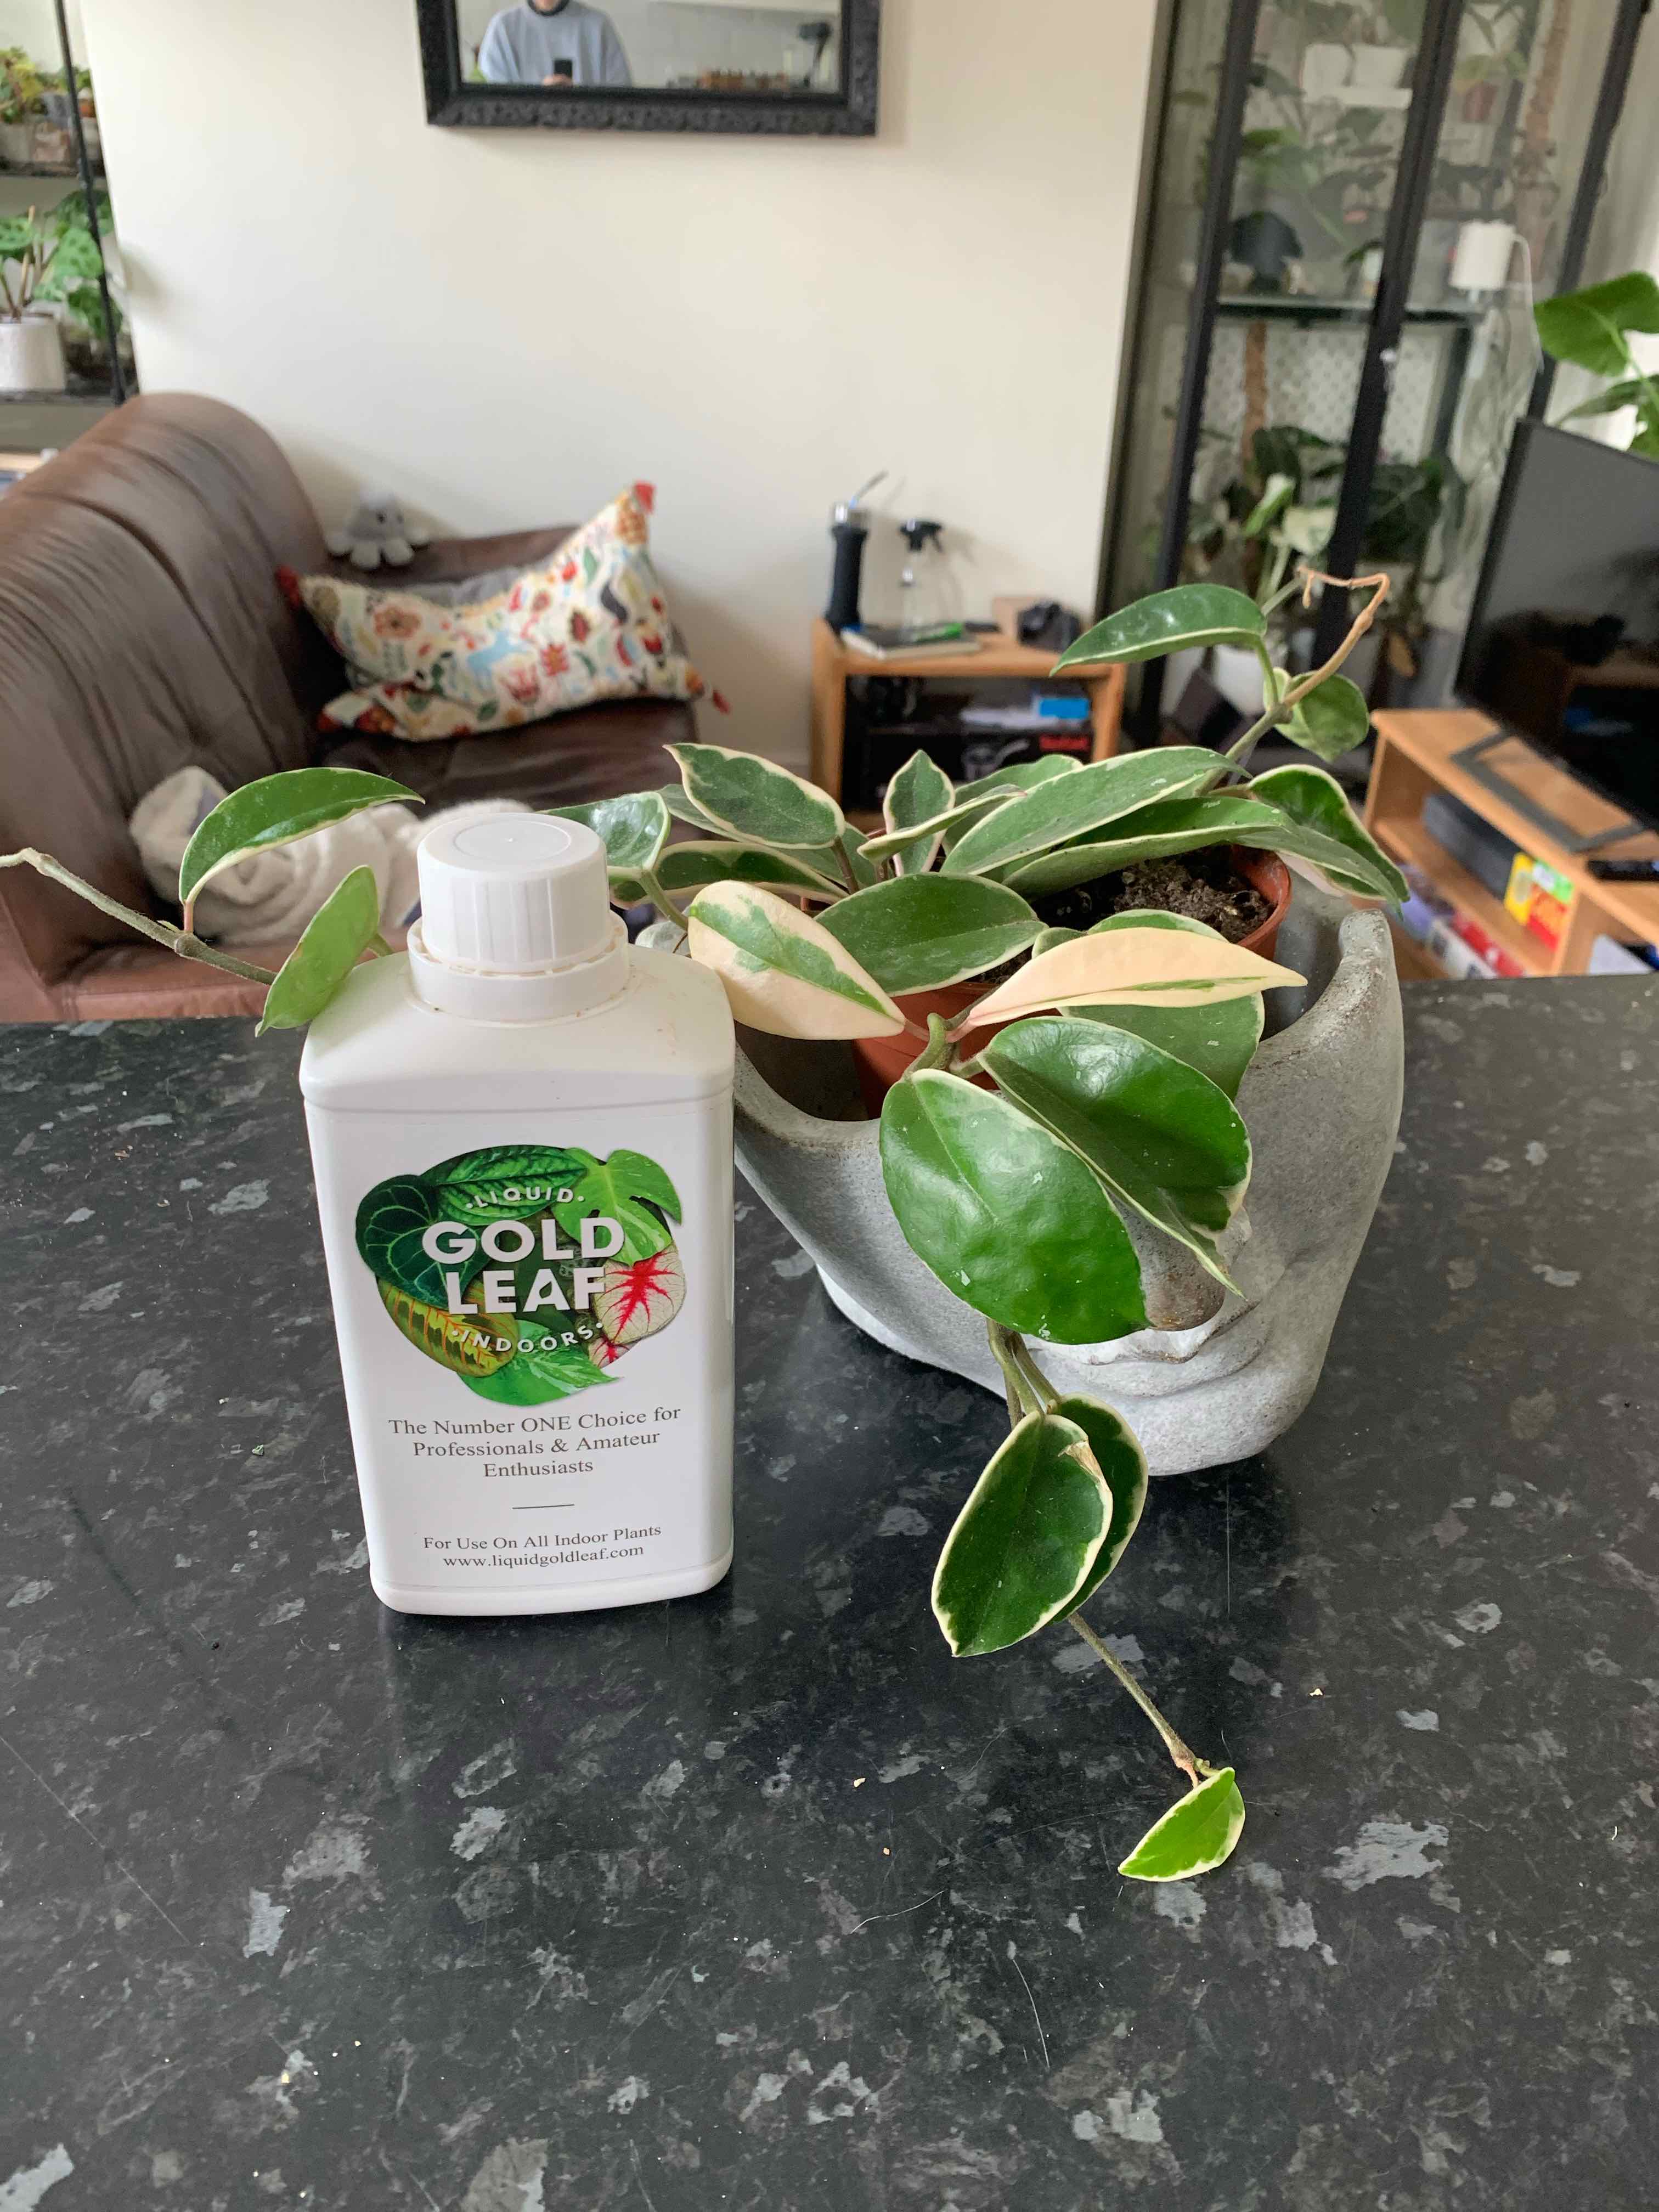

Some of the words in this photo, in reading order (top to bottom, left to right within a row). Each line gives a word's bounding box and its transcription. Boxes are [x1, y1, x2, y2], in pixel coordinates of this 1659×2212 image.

[422, 1217, 624, 1264] GOLD
[445, 1267, 606, 1315] LEAF
[388, 1420, 427, 1434] The
[433, 1420, 515, 1434] Number
[521, 1416, 571, 1432] ONE
[578, 1412, 646, 1429] Choice
[654, 1407, 681, 1421] for
[413, 1440, 544, 1457] Professionals
[551, 1438, 569, 1453] &
[575, 1433, 660, 1451] Amateur
[483, 1460, 593, 1477] Enthusiasts
[424, 1538, 452, 1549] For
[457, 1538, 487, 1549] Use
[493, 1537, 518, 1549] On
[523, 1536, 549, 1548] All
[555, 1533, 608, 1546] Indoor
[614, 1527, 661, 1541] Plants
[443, 1545, 644, 1568] www.liquidgoldleaf.com
